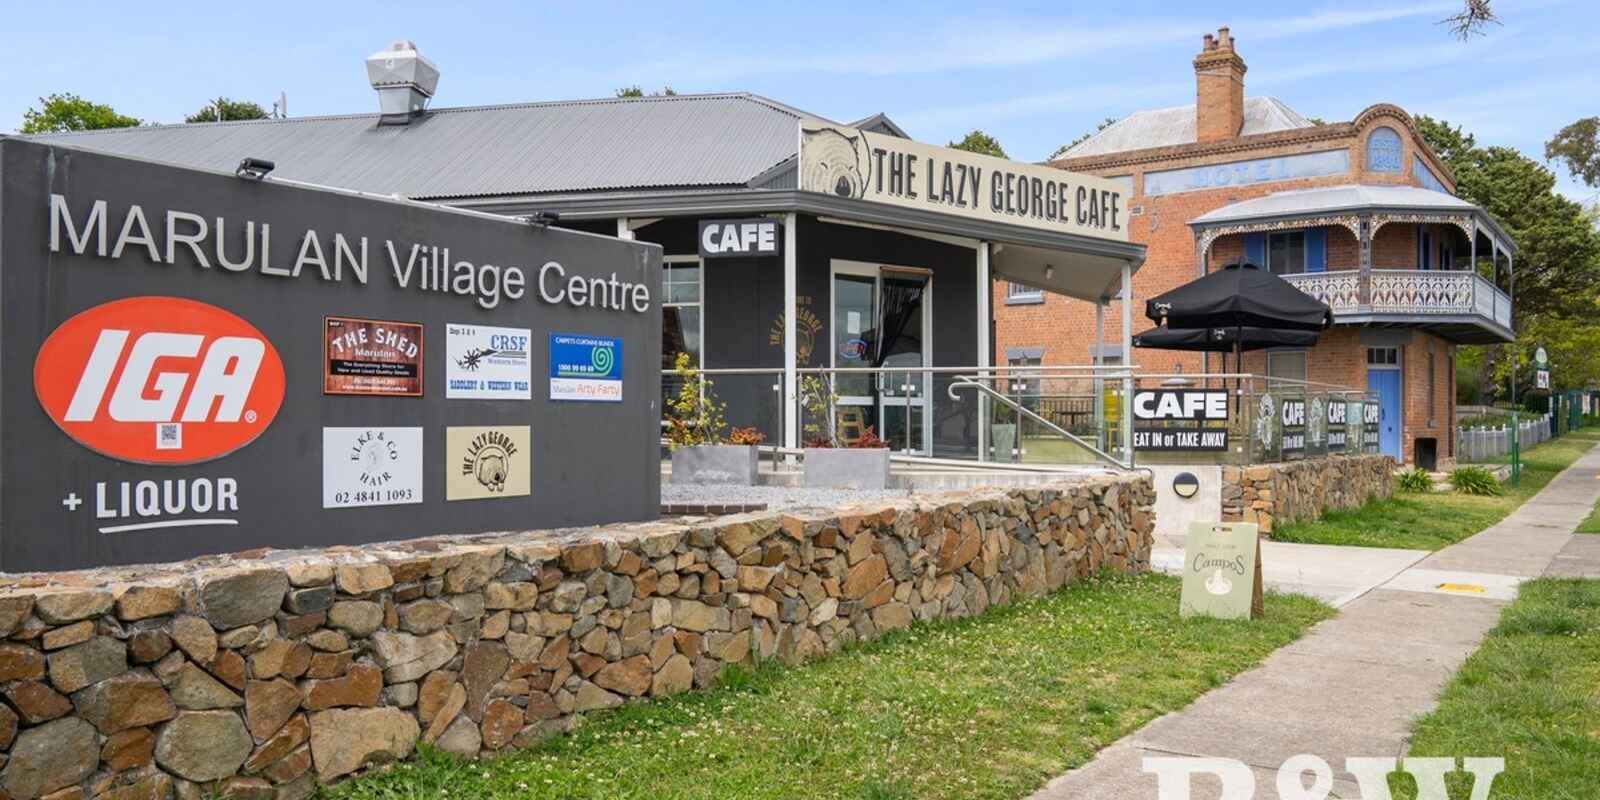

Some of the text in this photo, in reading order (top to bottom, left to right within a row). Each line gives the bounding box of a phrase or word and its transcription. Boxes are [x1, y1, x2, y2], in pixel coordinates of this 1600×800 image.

[873, 148, 1121, 232] THE LAZY GEORGE CAFE
[702, 223, 775, 253] CAFE
[50, 193, 650, 312] MARULAN Village Centre
[332, 328, 418, 358] THE SHED
[491, 335, 528, 351] CRSF
[63, 329, 266, 423] IGA
[1134, 392, 1227, 418] CAFE
[1282, 401, 1305, 426] CAFE
[1328, 401, 1346, 423] CAFE
[1364, 404, 1379, 423] CAFE
[351, 431, 398, 461] ELKE & CO
[1134, 432, 1226, 447] EAT IN or TAKE AWAY
[463, 431, 518, 476] THE LAZY GEORGE
[360, 471, 392, 486] HAIR
[96, 478, 239, 518] LIQUOR
[335, 489, 412, 503] 02 4841 1093
[1193, 552, 1245, 575] Campos
